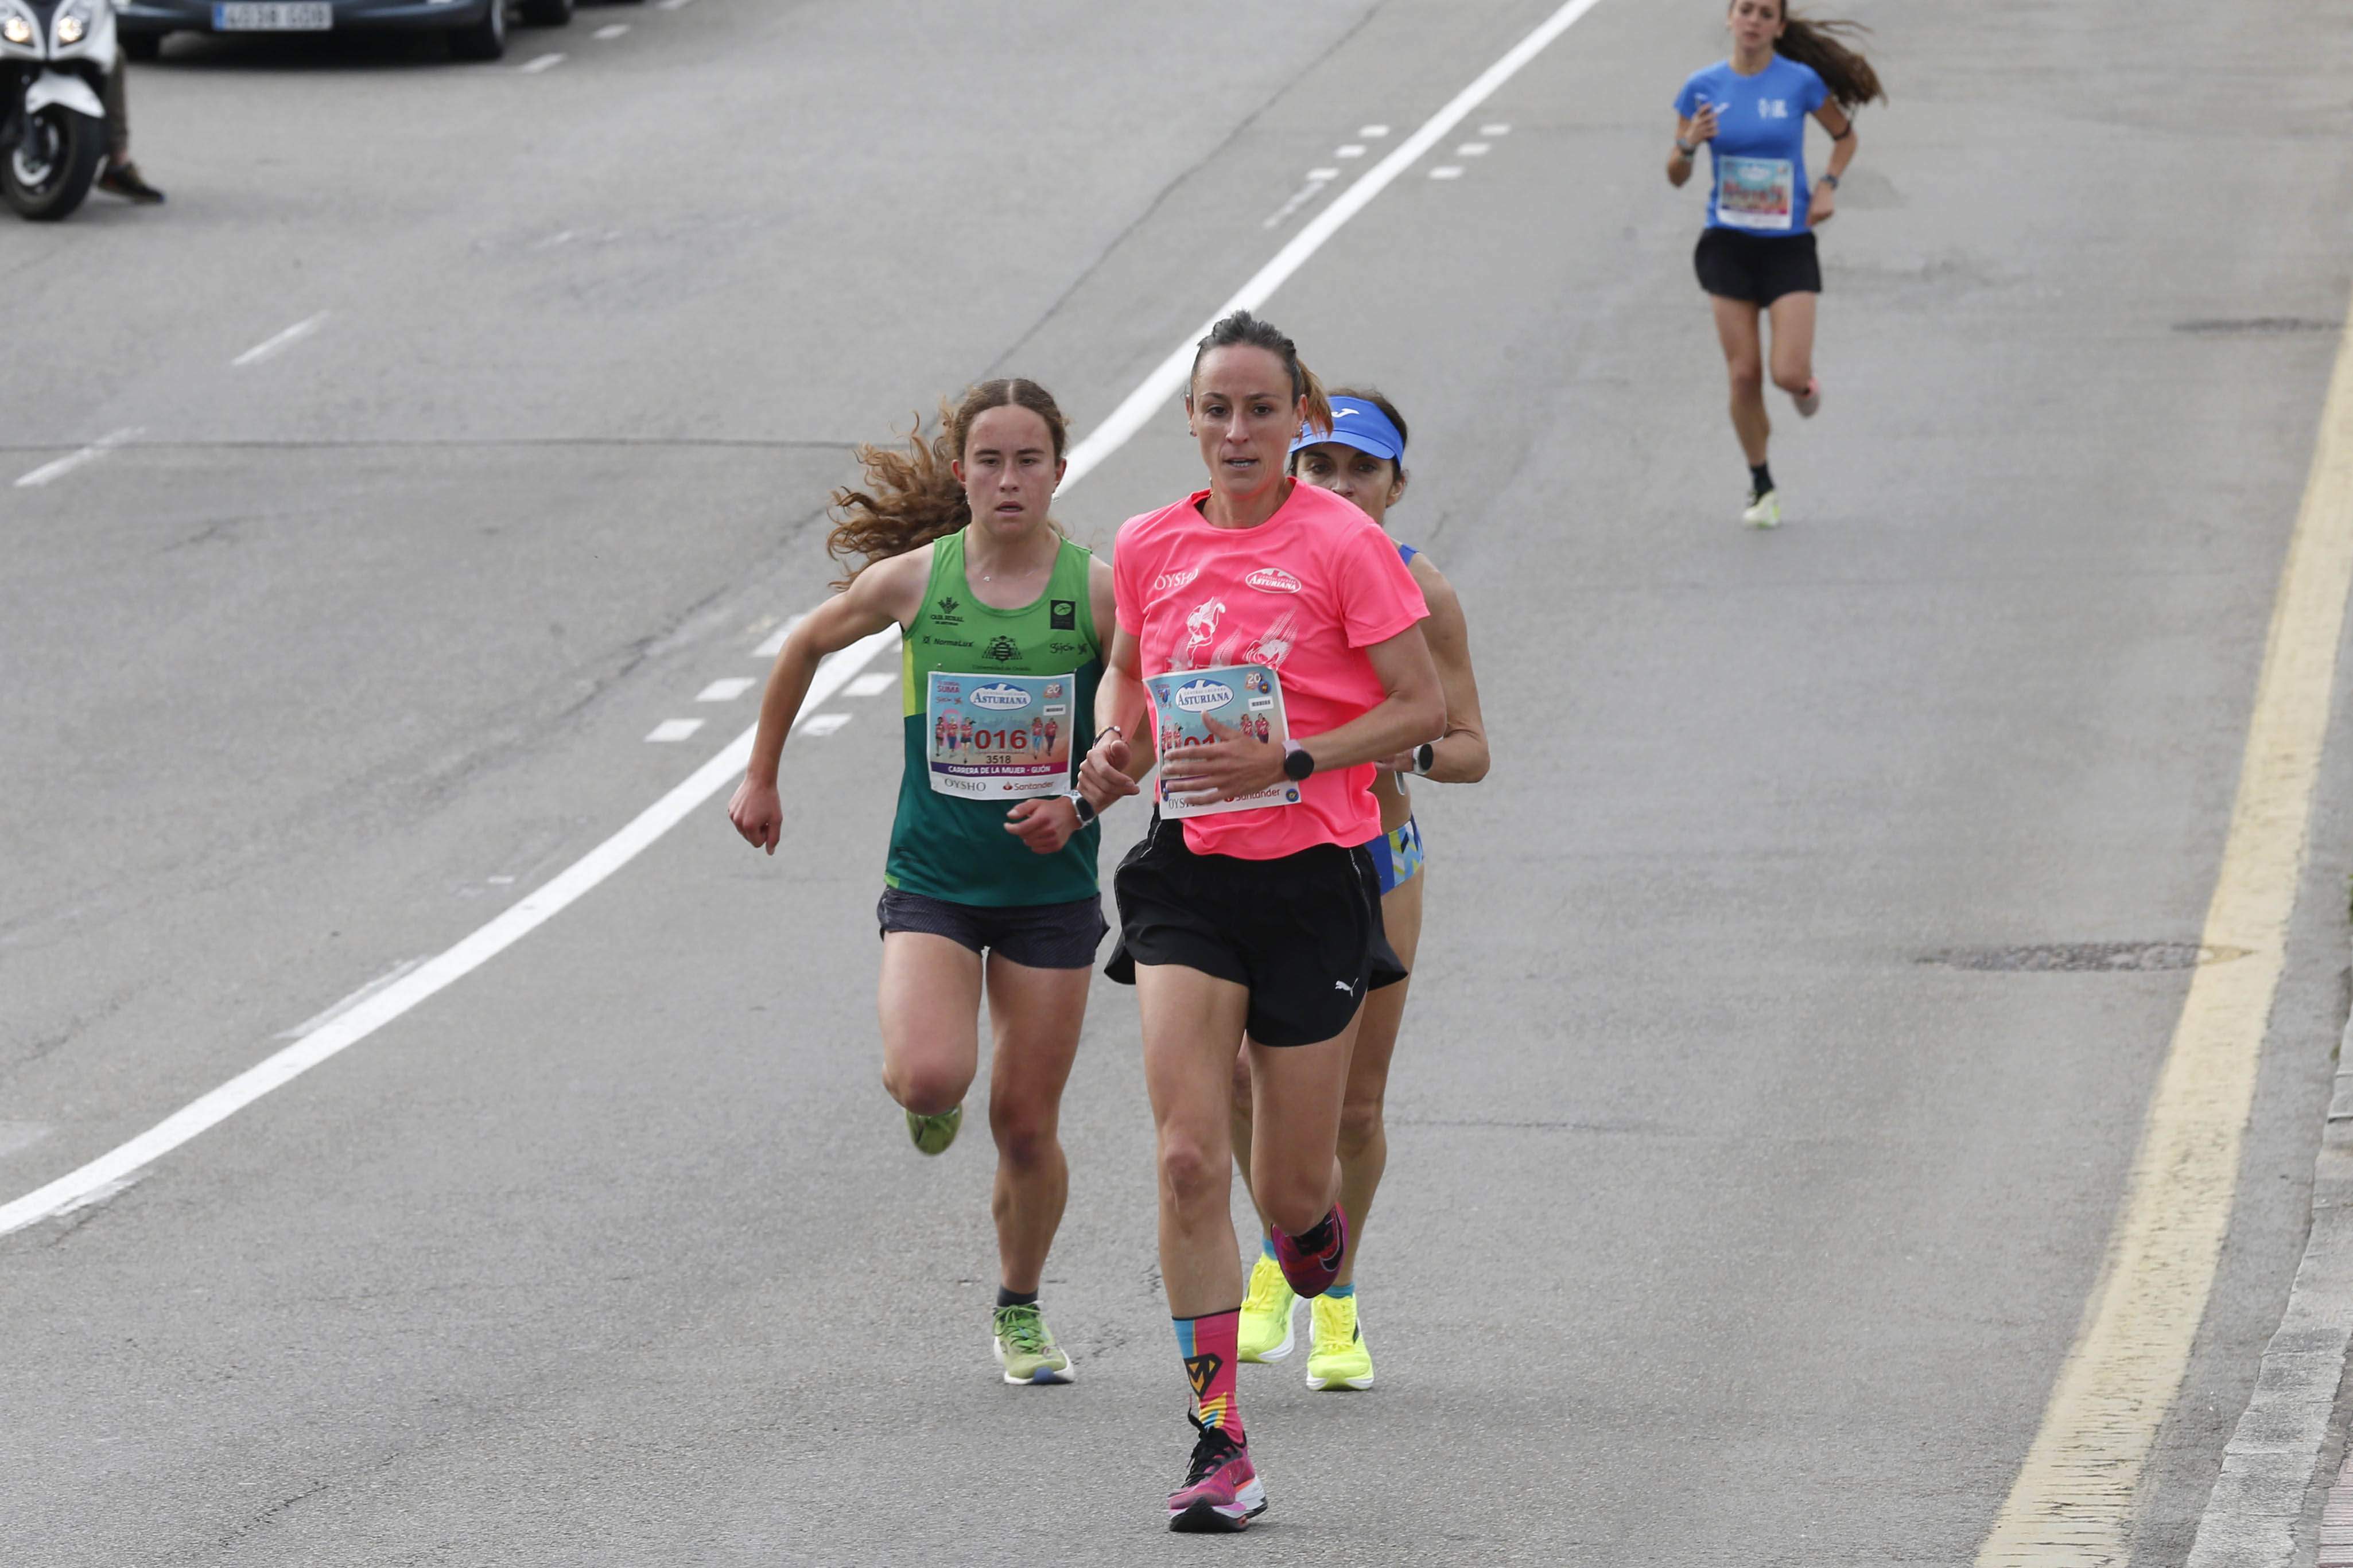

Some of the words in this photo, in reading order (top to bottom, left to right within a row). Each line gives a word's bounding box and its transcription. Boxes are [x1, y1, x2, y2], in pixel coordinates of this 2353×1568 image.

[1155, 569, 1198, 590] OYSHO
[1249, 575, 1296, 590] ASTURIANA
[1248, 674, 1261, 684] 20
[973, 692, 1028, 704] ASTURIANA
[1178, 691, 1230, 706] ASTURIANA
[974, 730, 1027, 749] 016
[986, 756, 1011, 764] 3518
[948, 766, 979, 774] CARRERA
[944, 778, 987, 792] OYSHO
[1014, 781, 1054, 791] Santander
